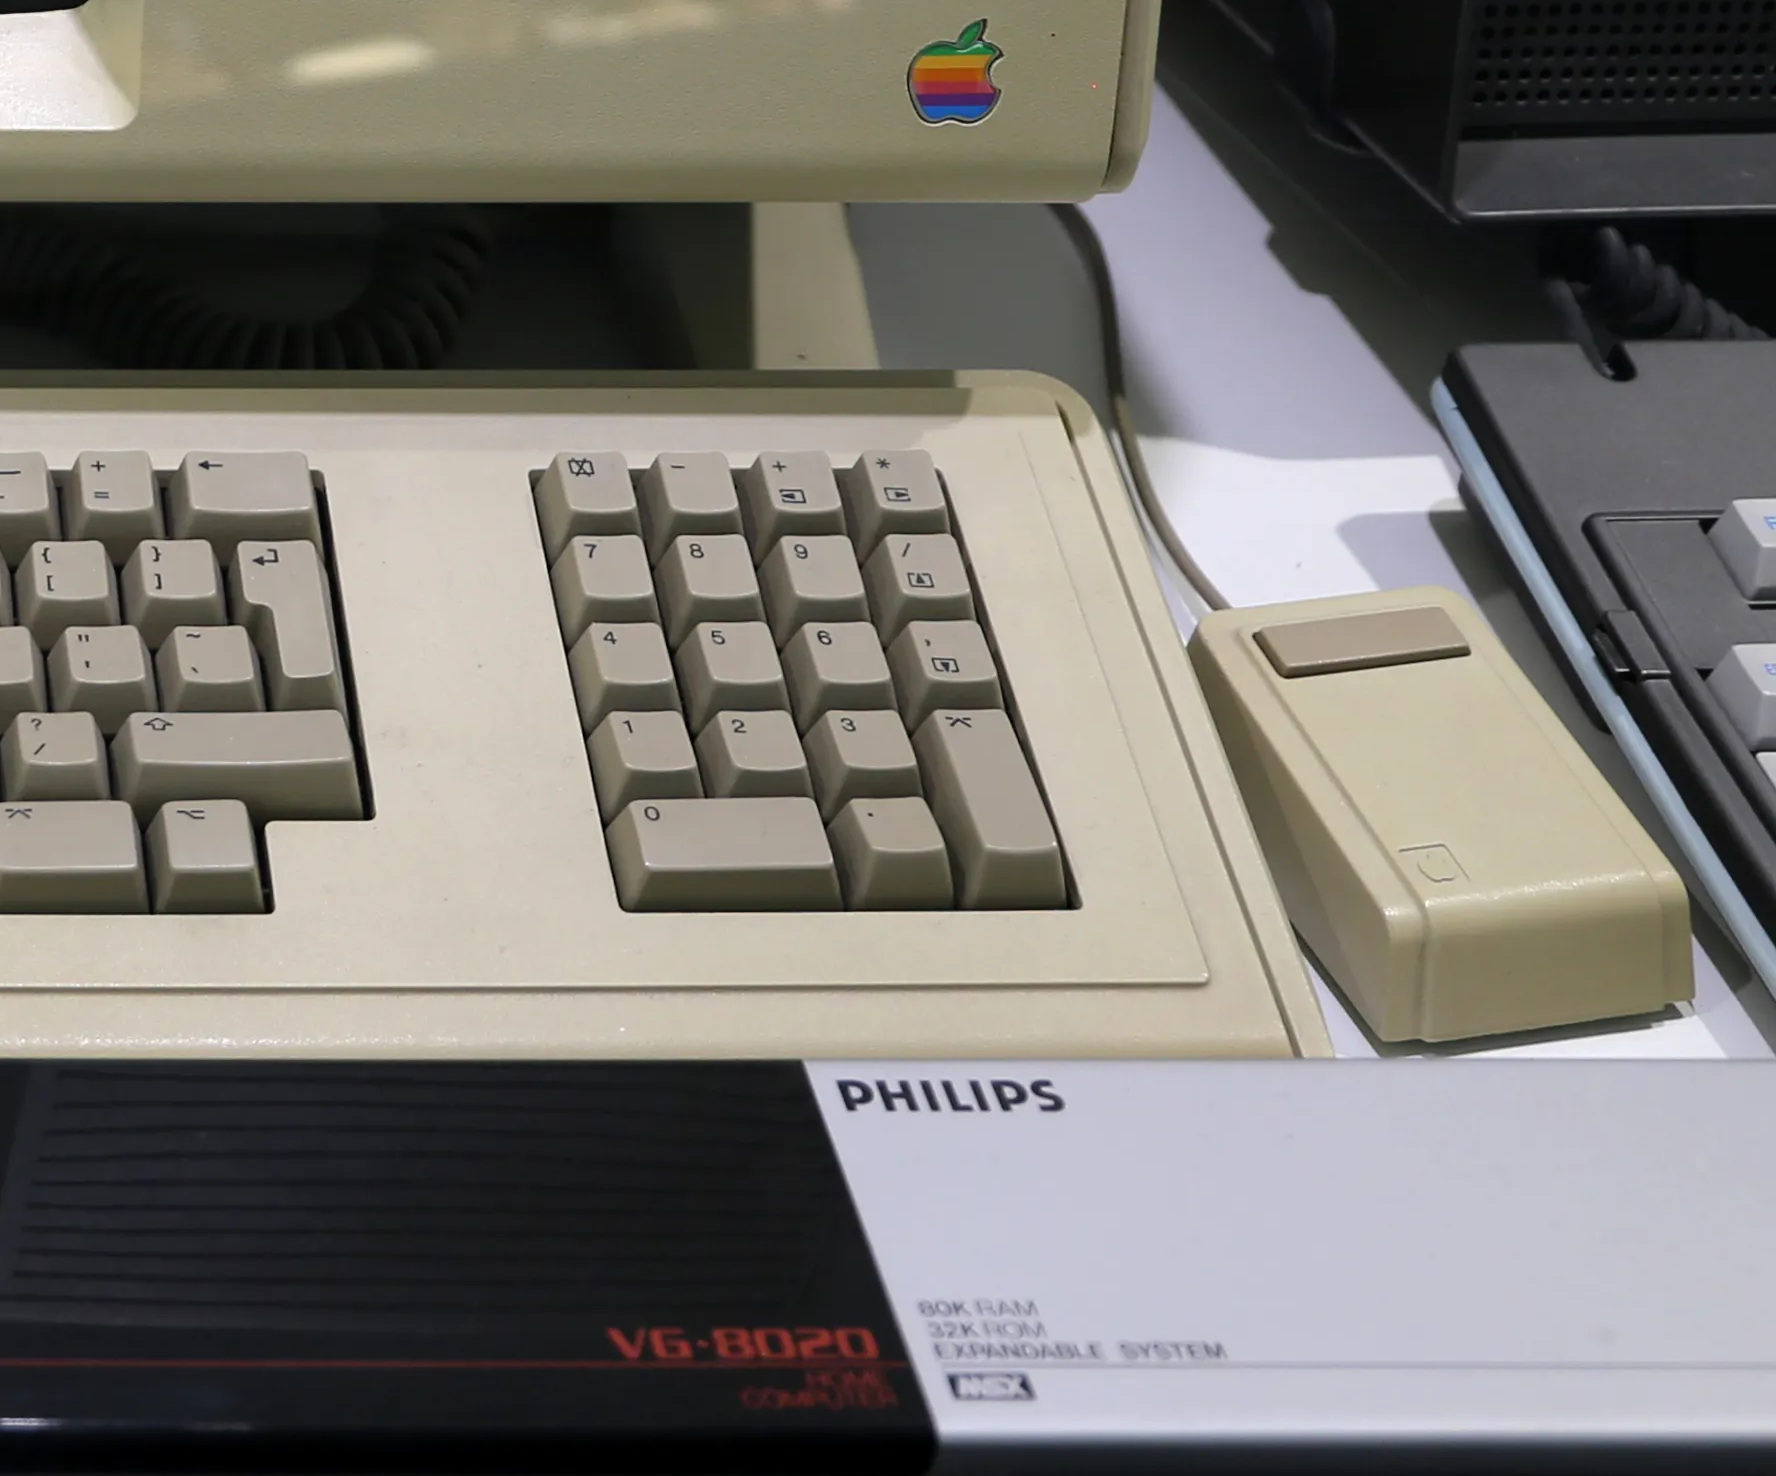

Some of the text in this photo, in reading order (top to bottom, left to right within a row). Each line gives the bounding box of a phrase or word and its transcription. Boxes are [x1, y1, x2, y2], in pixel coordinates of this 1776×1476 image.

[583, 542, 598, 560] 7
[688, 542, 706, 560] 8
[792, 542, 810, 561] 9
[602, 630, 618, 646] 4
[710, 629, 727, 647] 5
[815, 629, 834, 647] 6
[621, 718, 635, 735] 1
[730, 717, 748, 735] 2
[839, 716, 858, 734] 3
[642, 805, 662, 823] 0
[836, 1079, 1066, 1112] PHILIPS
[917, 1300, 1039, 1318] 80K RAM
[928, 1321, 1048, 1339] 32K ROM
[606, 1327, 880, 1360] VG-8020
[933, 1341, 1229, 1360] EXPANDABLE SYSTEM
[954, 1375, 1029, 1400] MSX
